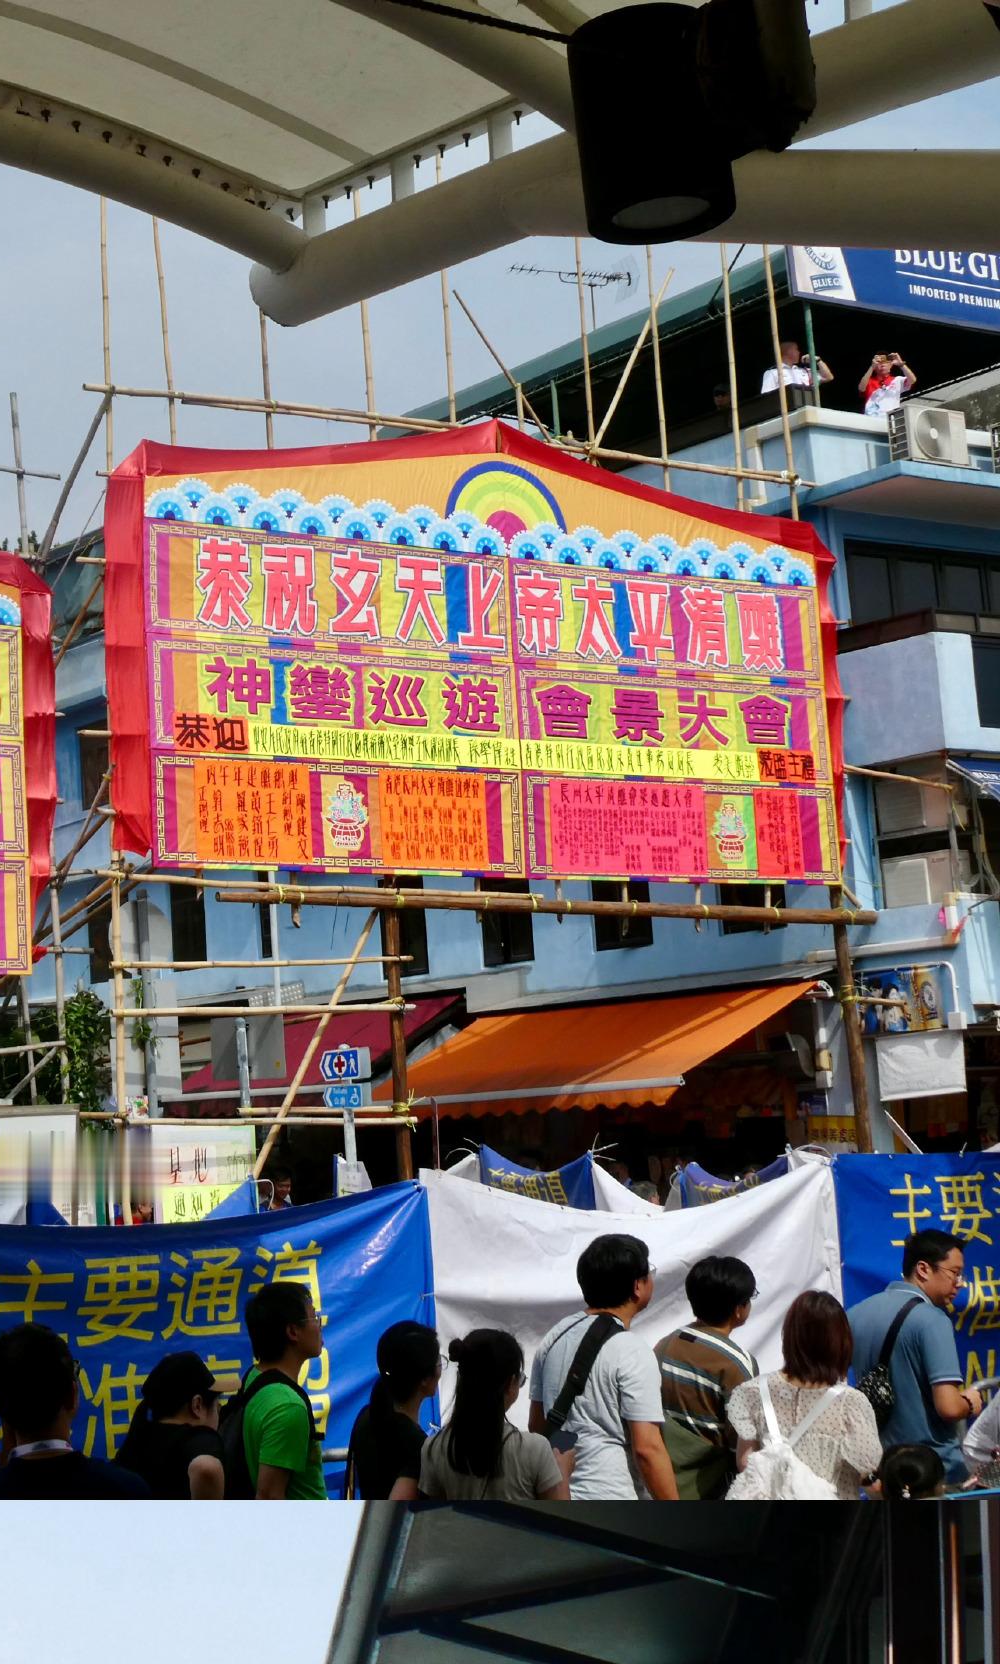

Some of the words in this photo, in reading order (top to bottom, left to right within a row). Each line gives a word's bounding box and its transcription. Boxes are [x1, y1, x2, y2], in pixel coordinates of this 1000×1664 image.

[909, 284, 957, 302] IMPORTED
[175, 713, 249, 751] 恭迎
[889, 1171, 1000, 1246] 主要
